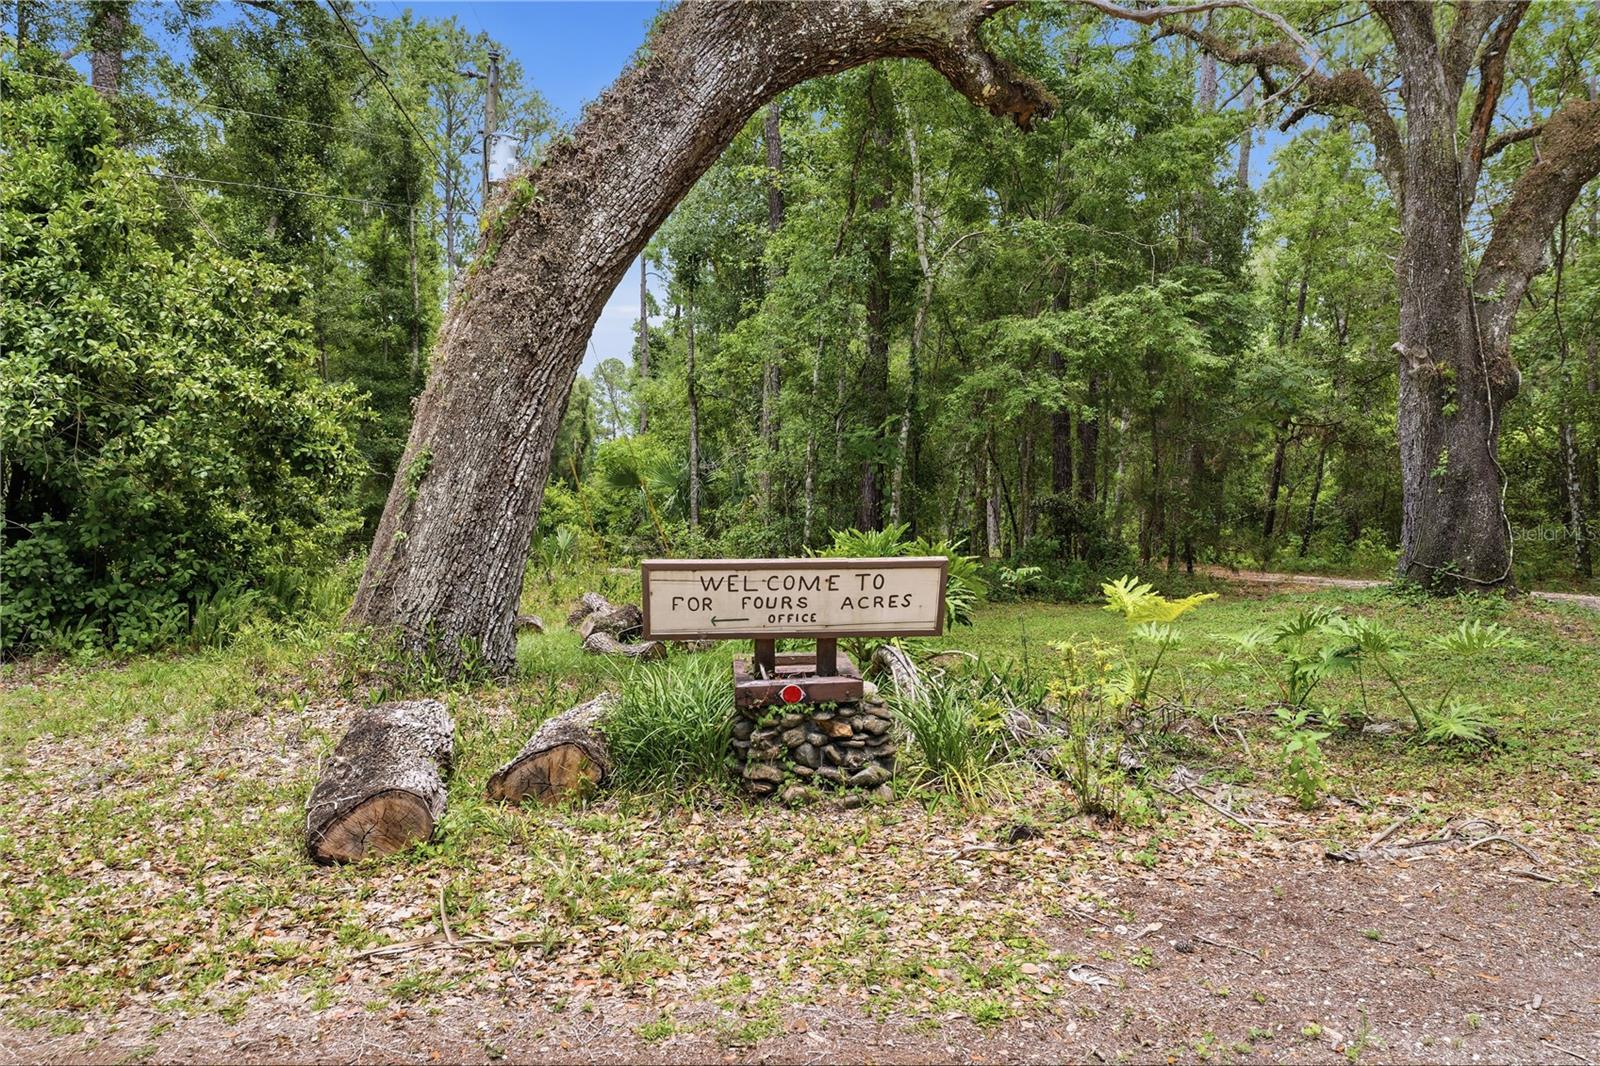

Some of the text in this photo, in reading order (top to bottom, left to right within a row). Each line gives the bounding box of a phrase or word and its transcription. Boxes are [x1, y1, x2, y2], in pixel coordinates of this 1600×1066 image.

[699, 573, 885, 592] WELCOME TO
[671, 593, 912, 611] FOR FOURS ACRES
[767, 612, 817, 624] OFFICE
